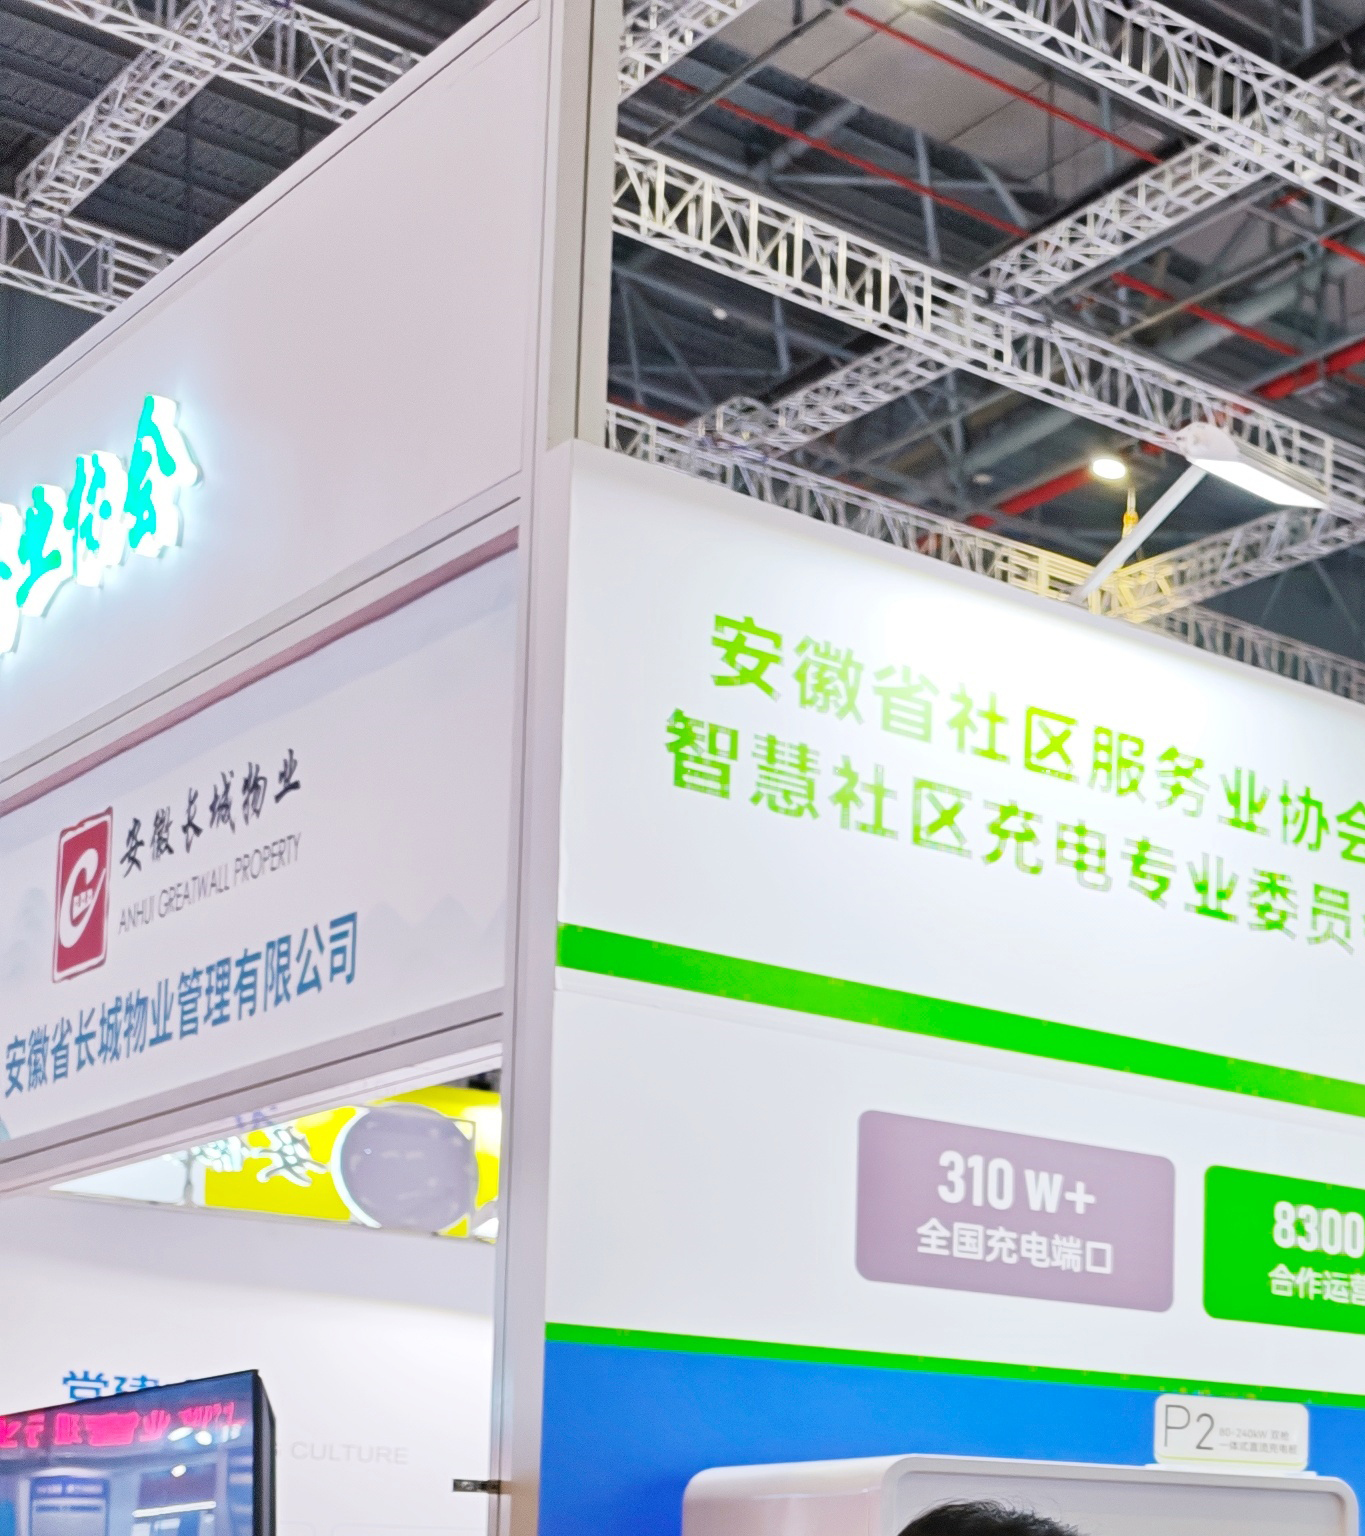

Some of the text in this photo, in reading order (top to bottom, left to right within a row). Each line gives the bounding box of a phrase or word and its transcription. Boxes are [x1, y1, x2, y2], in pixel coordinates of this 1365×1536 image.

[120, 748, 302, 877] 安徽长城物业
[118, 830, 302, 936] ANHUI GREATWALL PROPERTY
[4, 911, 359, 1098] 安徽省长城物业管理有限公司
[937, 1150, 1096, 1217] 310 W+
[917, 1218, 1114, 1276] 全国充电端口
[1164, 1404, 1214, 1450] P2
